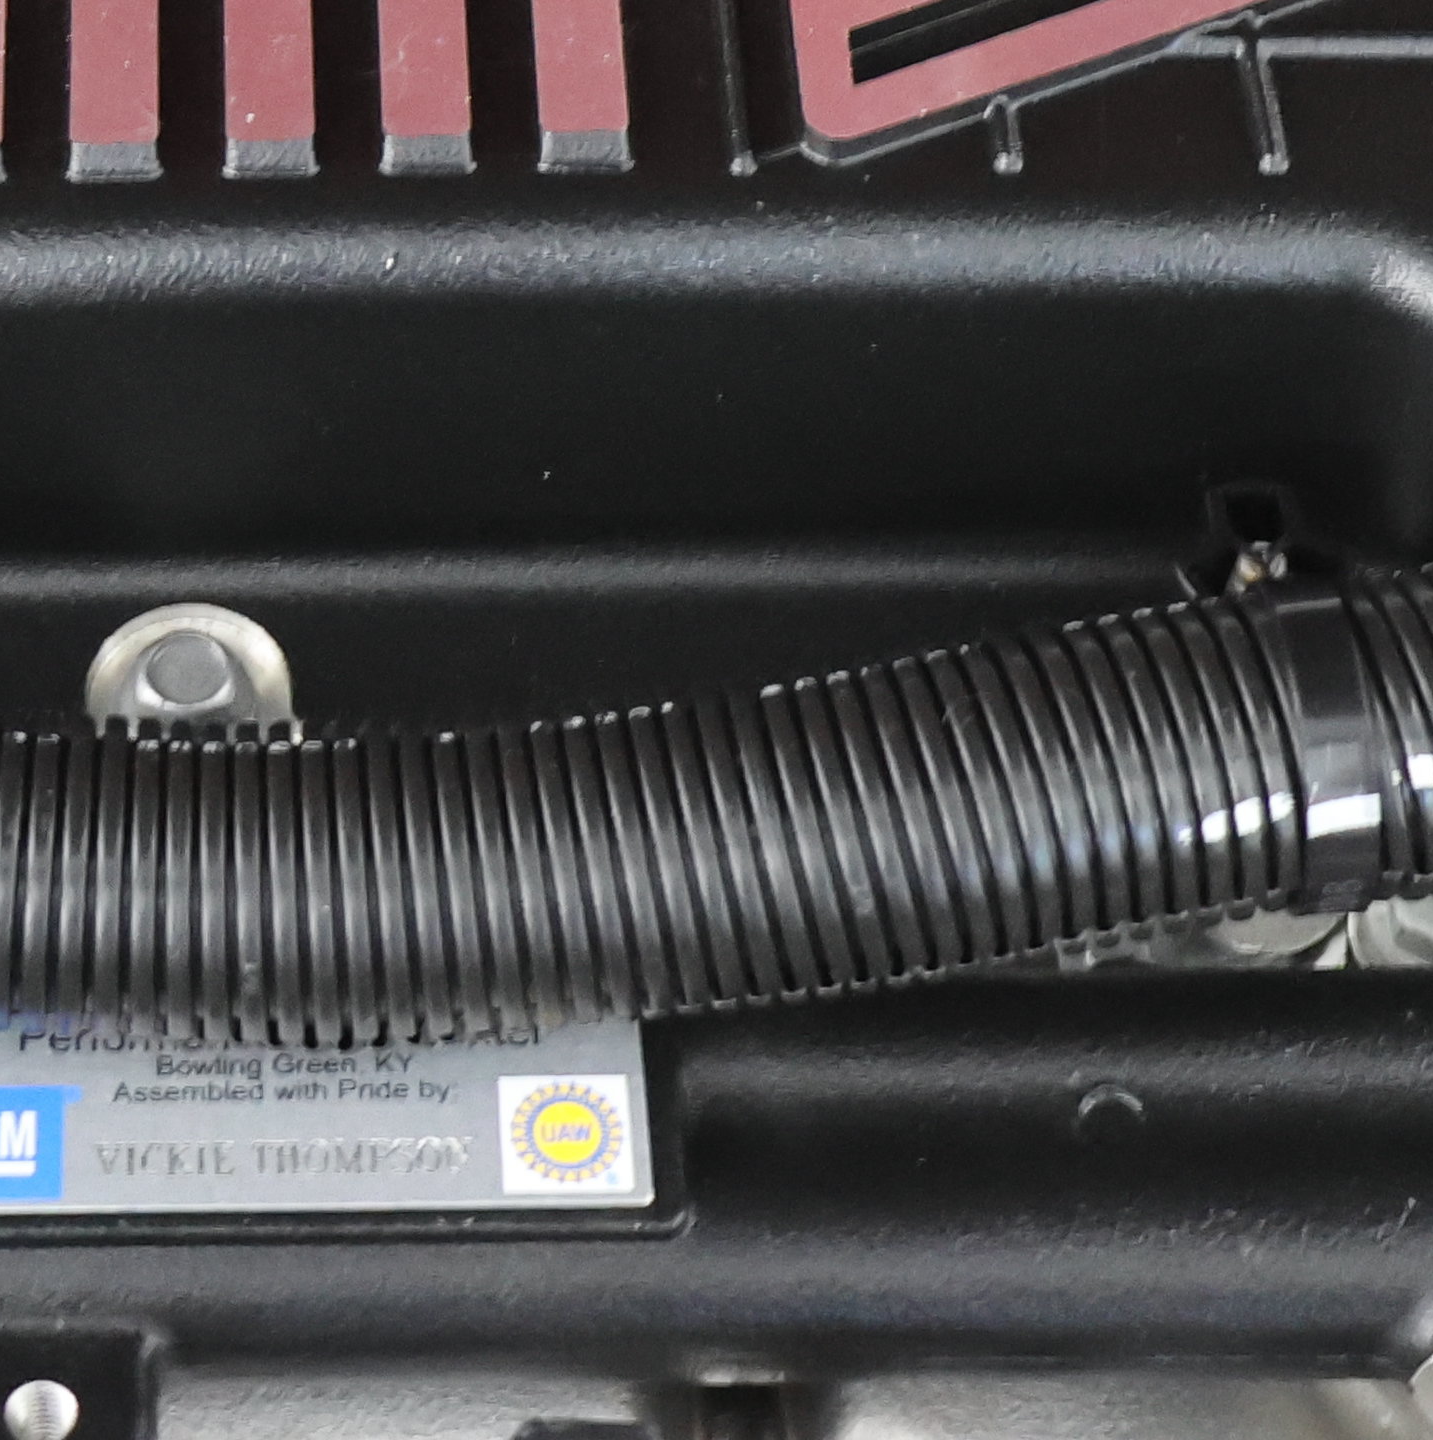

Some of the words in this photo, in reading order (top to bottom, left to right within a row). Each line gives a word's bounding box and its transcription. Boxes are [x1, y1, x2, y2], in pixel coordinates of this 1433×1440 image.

[156, 1053, 262, 1080] Bowling
[375, 1052, 414, 1073] KY
[112, 1081, 264, 1103] Assembled
[275, 1081, 328, 1101] with
[338, 1078, 410, 1100] Pride
[540, 1122, 593, 1143] UAW
[94, 1139, 235, 1176] VICKIE
[250, 1135, 474, 1176] THOMPSON
